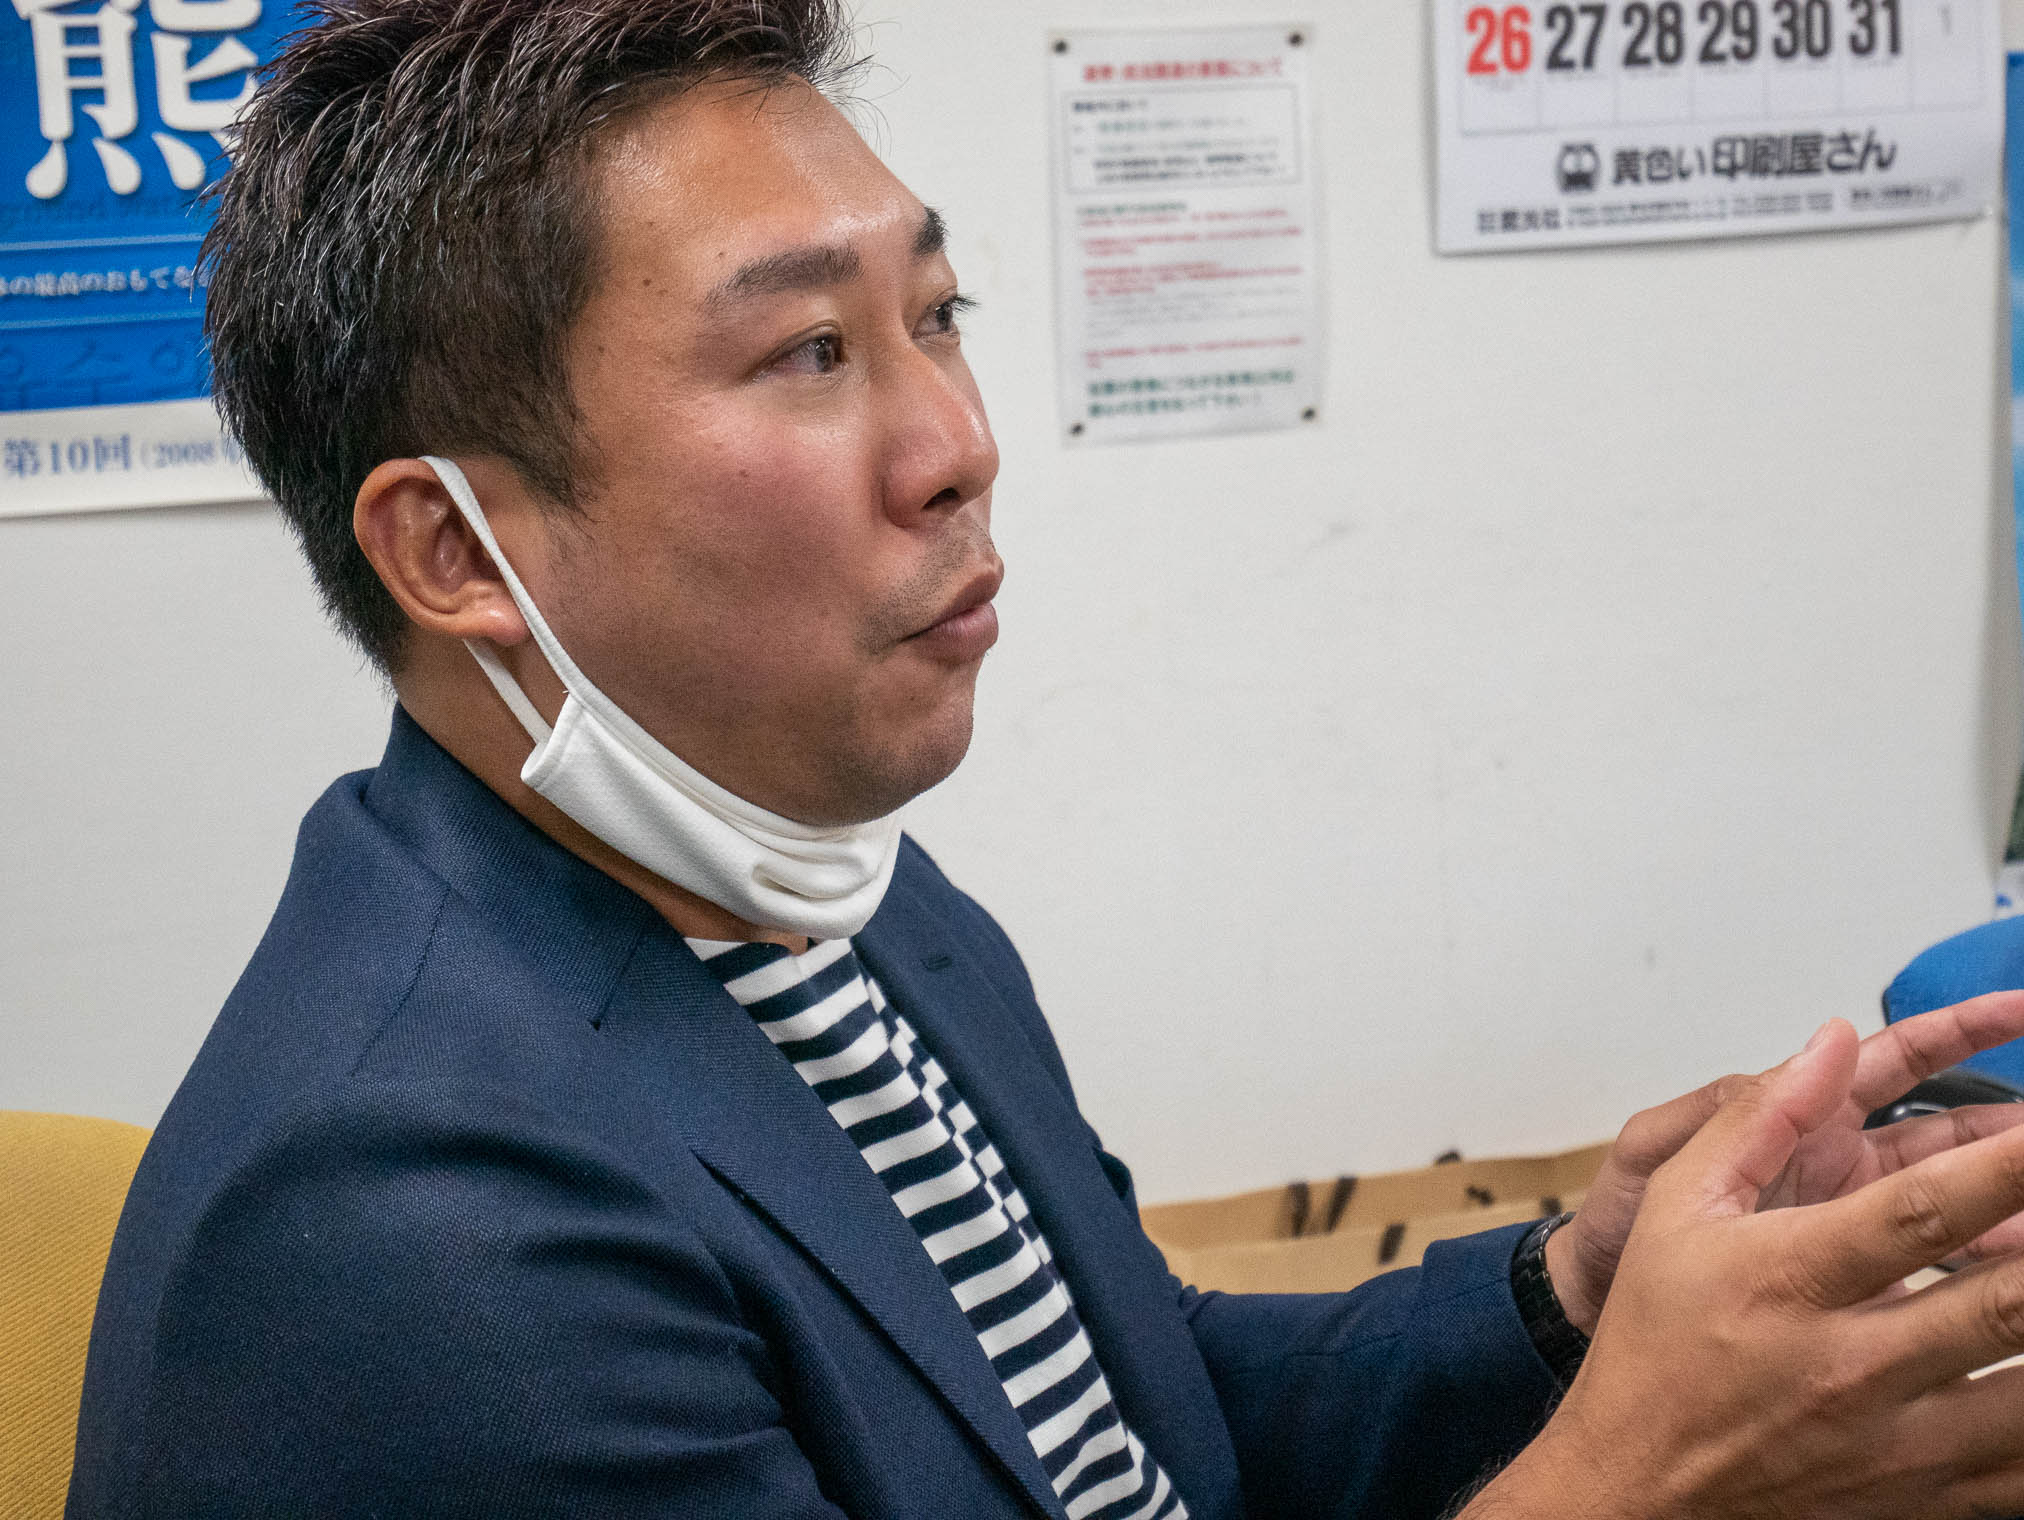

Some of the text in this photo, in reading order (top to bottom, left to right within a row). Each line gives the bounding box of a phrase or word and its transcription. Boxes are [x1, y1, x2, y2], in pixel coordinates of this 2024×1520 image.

[1465, 5, 1532, 75] 26
[1545, 3, 1607, 70] 27
[1622, 1, 1685, 67] 28
[1699, 0, 1759, 62] 29
[1772, 0, 1832, 59] 30
[1849, 0, 1901, 54] 31
[11, 0, 262, 199] 熊
[1612, 127, 1898, 185] 黄色い印刷屋さん
